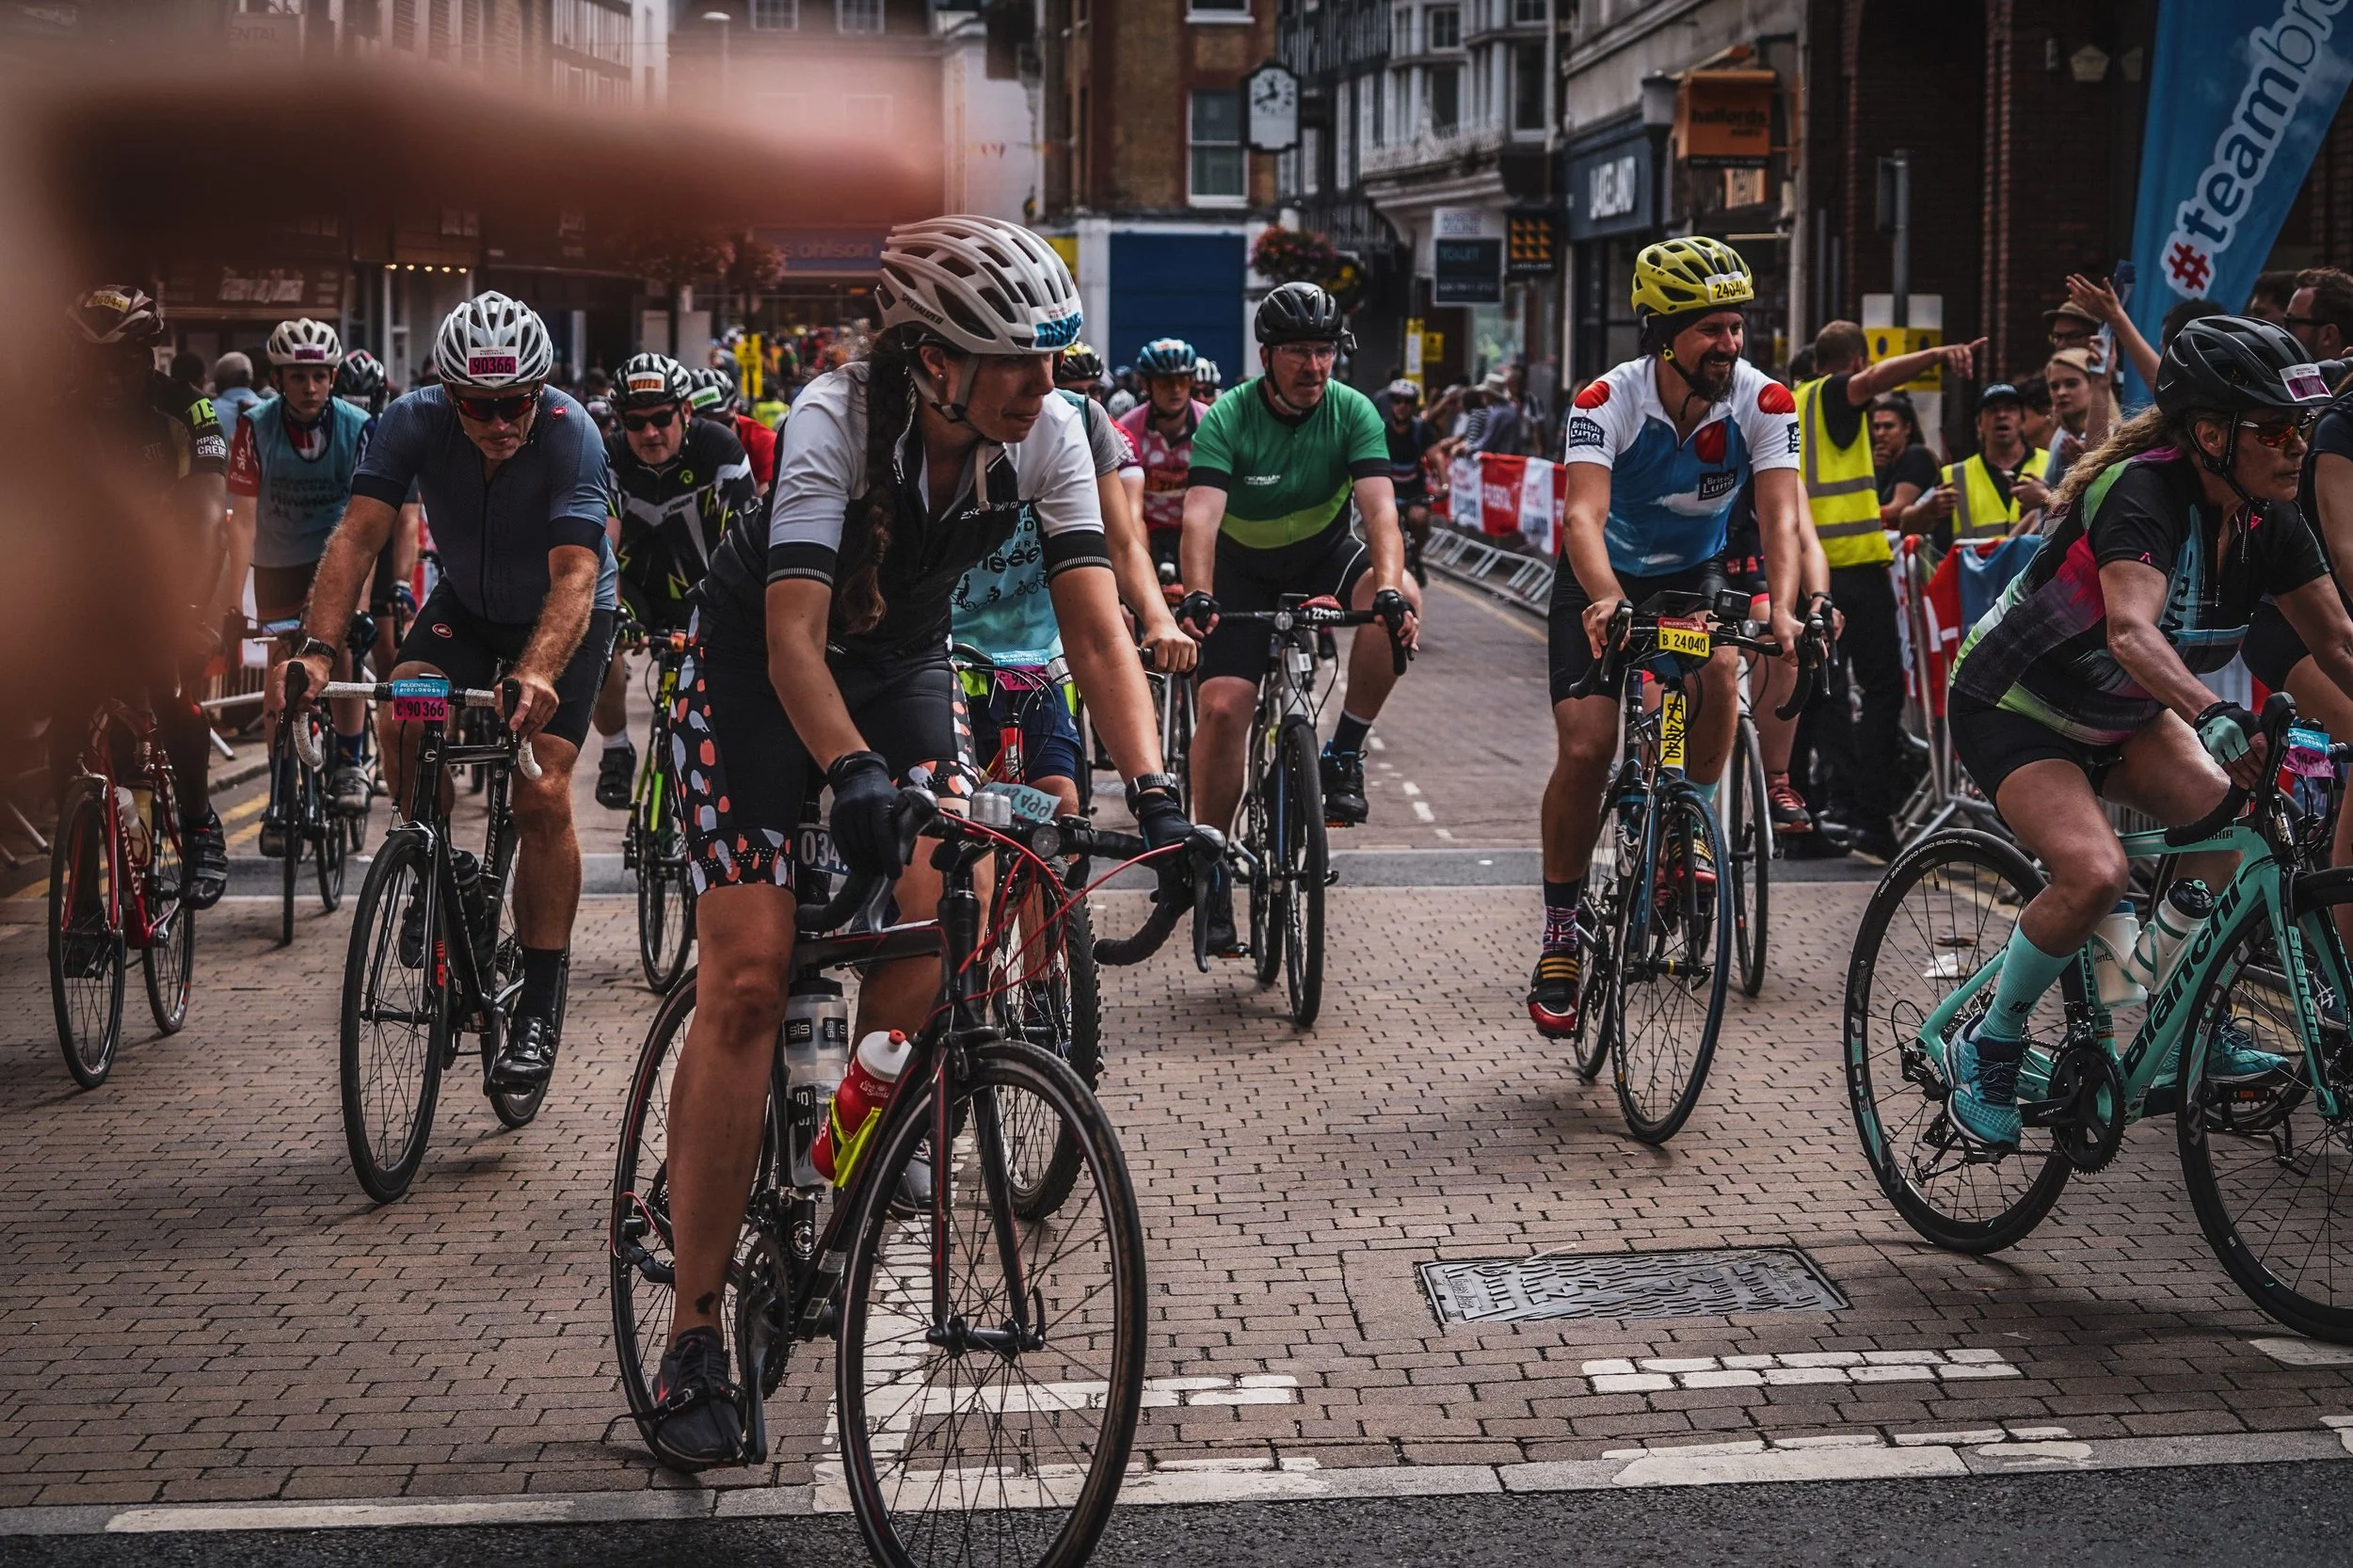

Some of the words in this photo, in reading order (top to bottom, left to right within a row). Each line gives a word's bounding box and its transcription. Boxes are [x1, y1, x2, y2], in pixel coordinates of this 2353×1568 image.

[2165, 0, 2340, 293] #teambr
[1715, 280, 1746, 299] 24040
[901, 293, 945, 325] SPECIALIZED
[472, 357, 513, 374] 90366
[1572, 421, 1601, 434] British
[1703, 478, 1734, 493] Lung
[1706, 472, 1734, 485] British
[1662, 634, 1669, 647] B
[1674, 634, 1706, 653] 24040
[396, 703, 403, 716] C
[408, 701, 444, 717] 90366
[1890, 851, 1920, 880] ZAFFIRO
[1919, 842, 1936, 855] PRO
[1935, 839, 1959, 848] SLICK
[2124, 883, 2244, 1080] Bianchi
[2287, 925, 2322, 1045] Bianchi
